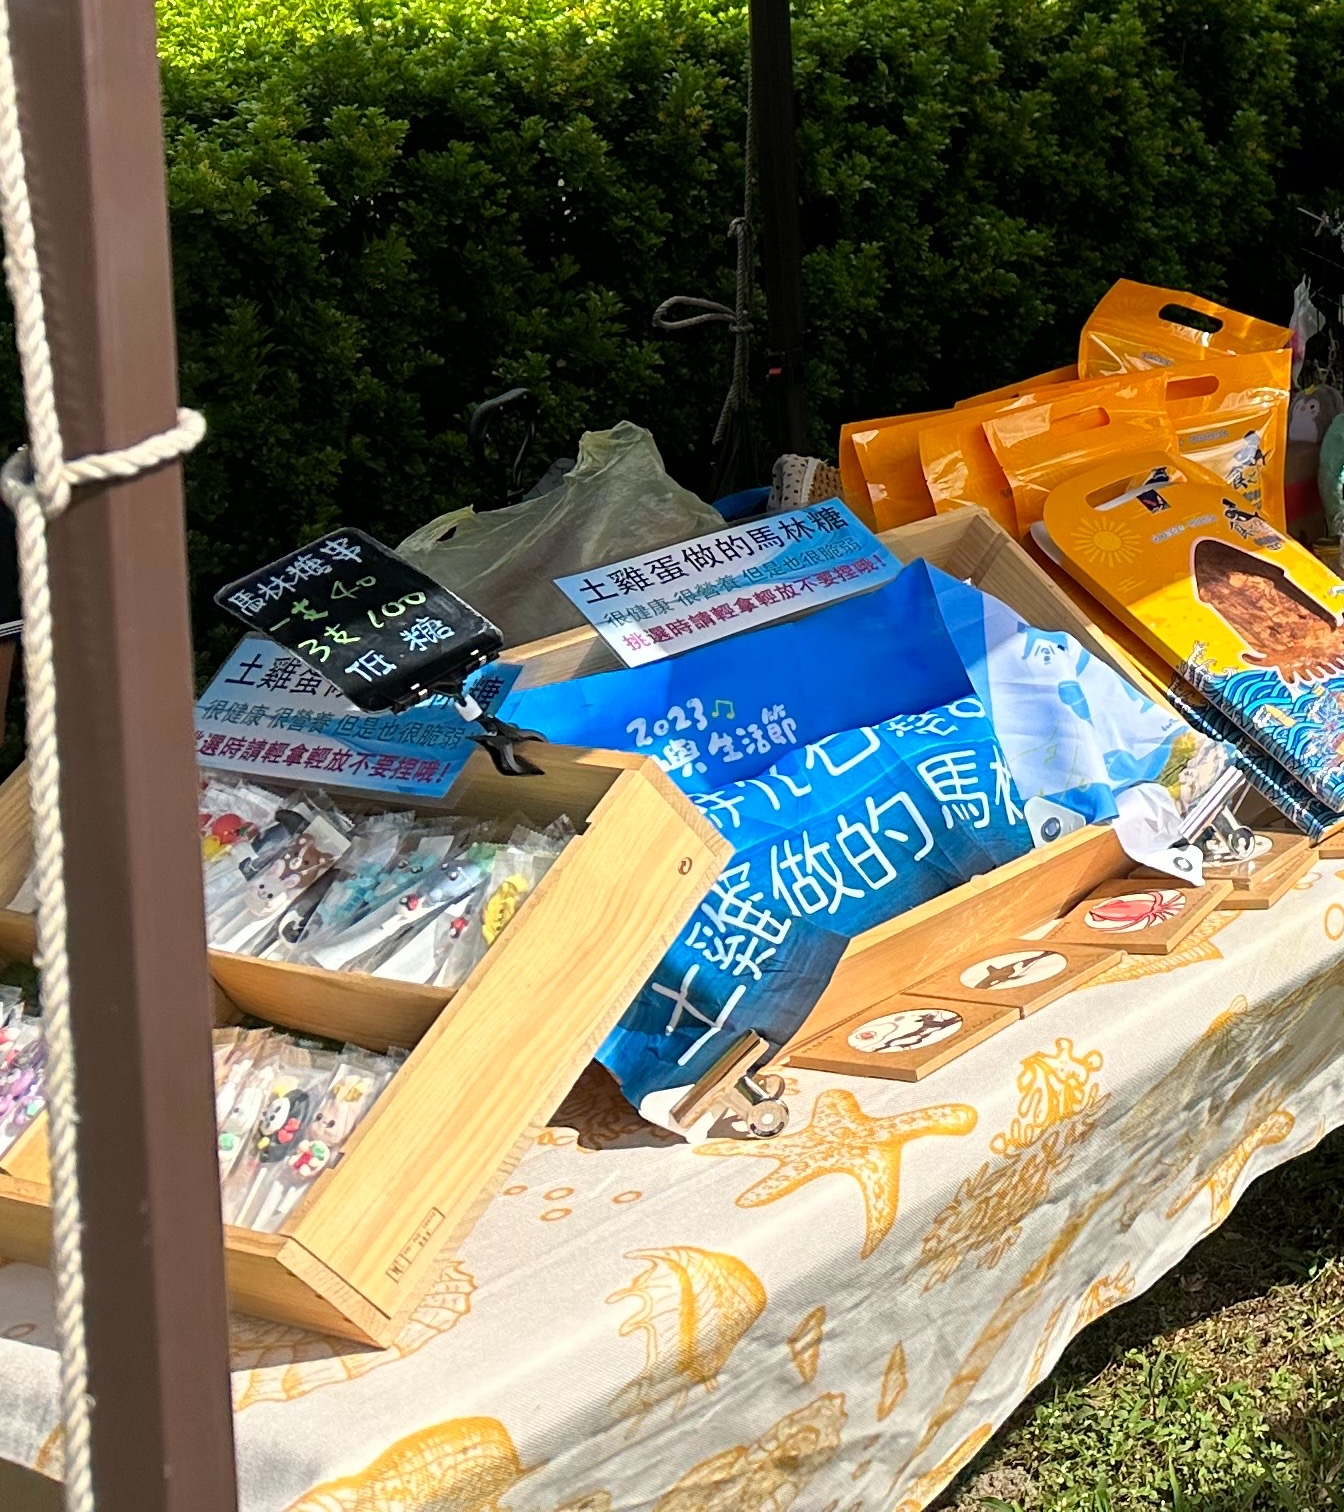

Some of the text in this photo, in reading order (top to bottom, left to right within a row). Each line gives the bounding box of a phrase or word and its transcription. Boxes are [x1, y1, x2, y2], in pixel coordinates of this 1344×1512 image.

[579, 506, 849, 605] 土雞蛋做的馬林糖
[228, 538, 362, 617] 馬林糖串
[330, 576, 376, 600] 40
[368, 591, 427, 628] 100
[604, 597, 674, 629] 很健康
[345, 616, 455, 682] 低糖
[200, 698, 267, 727] 很健康
[626, 697, 708, 747] 2023
